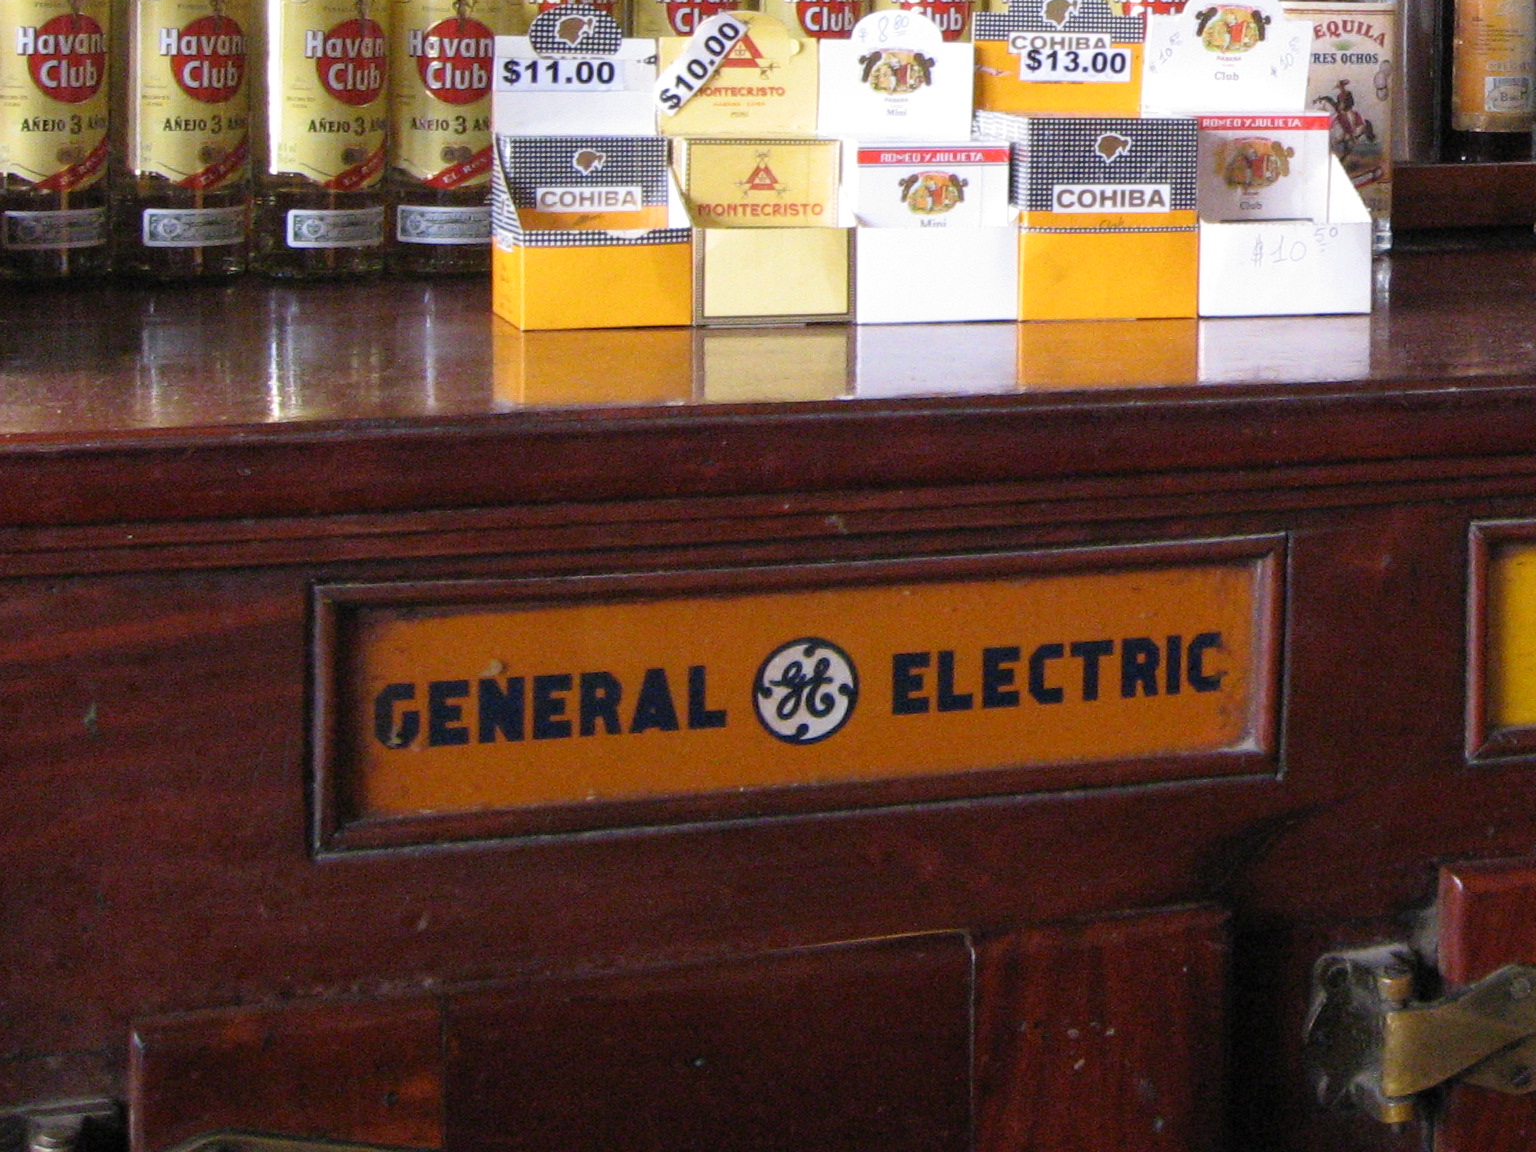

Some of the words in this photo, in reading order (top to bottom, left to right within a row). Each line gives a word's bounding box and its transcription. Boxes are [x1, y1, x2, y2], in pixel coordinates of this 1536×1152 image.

[804, 6, 856, 35] Club
[304, 28, 386, 59] Havan
[408, 29, 493, 58] Havan
[1010, 35, 1108, 51] COHIBA
[1314, 19, 1387, 48] EQUILA
[659, 22, 740, 110] $10.00
[1025, 49, 1126, 75] $13.00
[1341, 52, 1379, 66] OCHOS
[39, 59, 98, 89] Club
[181, 59, 239, 90] Club
[326, 62, 381, 92] Club
[425, 62, 488, 90] Club
[502, 59, 615, 87] $11.00
[1214, 71, 1239, 81] Club
[20, 115, 67, 133] AÑEJO
[70, 113, 83, 134] 3
[163, 114, 207, 132] AÑEJO
[210, 113, 223, 134] 3
[307, 116, 351, 134] AÑEJO
[353, 115, 366, 135] 3
[410, 116, 450, 132] AÑEJO
[452, 114, 467, 135] 3
[1202, 119, 1241, 127] ROMEO
[1251, 118, 1302, 127] JULIETA
[880, 152, 920, 163] ROMEO
[932, 152, 984, 163] JULIETA
[539, 190, 639, 209] COHIBA
[1056, 189, 1166, 208] COHIBA
[1239, 201, 1262, 210] Club
[698, 202, 824, 218] MONTECRISTO
[920, 218, 947, 228] Mini
[372, 666, 727, 751] GENERAL
[891, 632, 1223, 716] ELECTRIC
